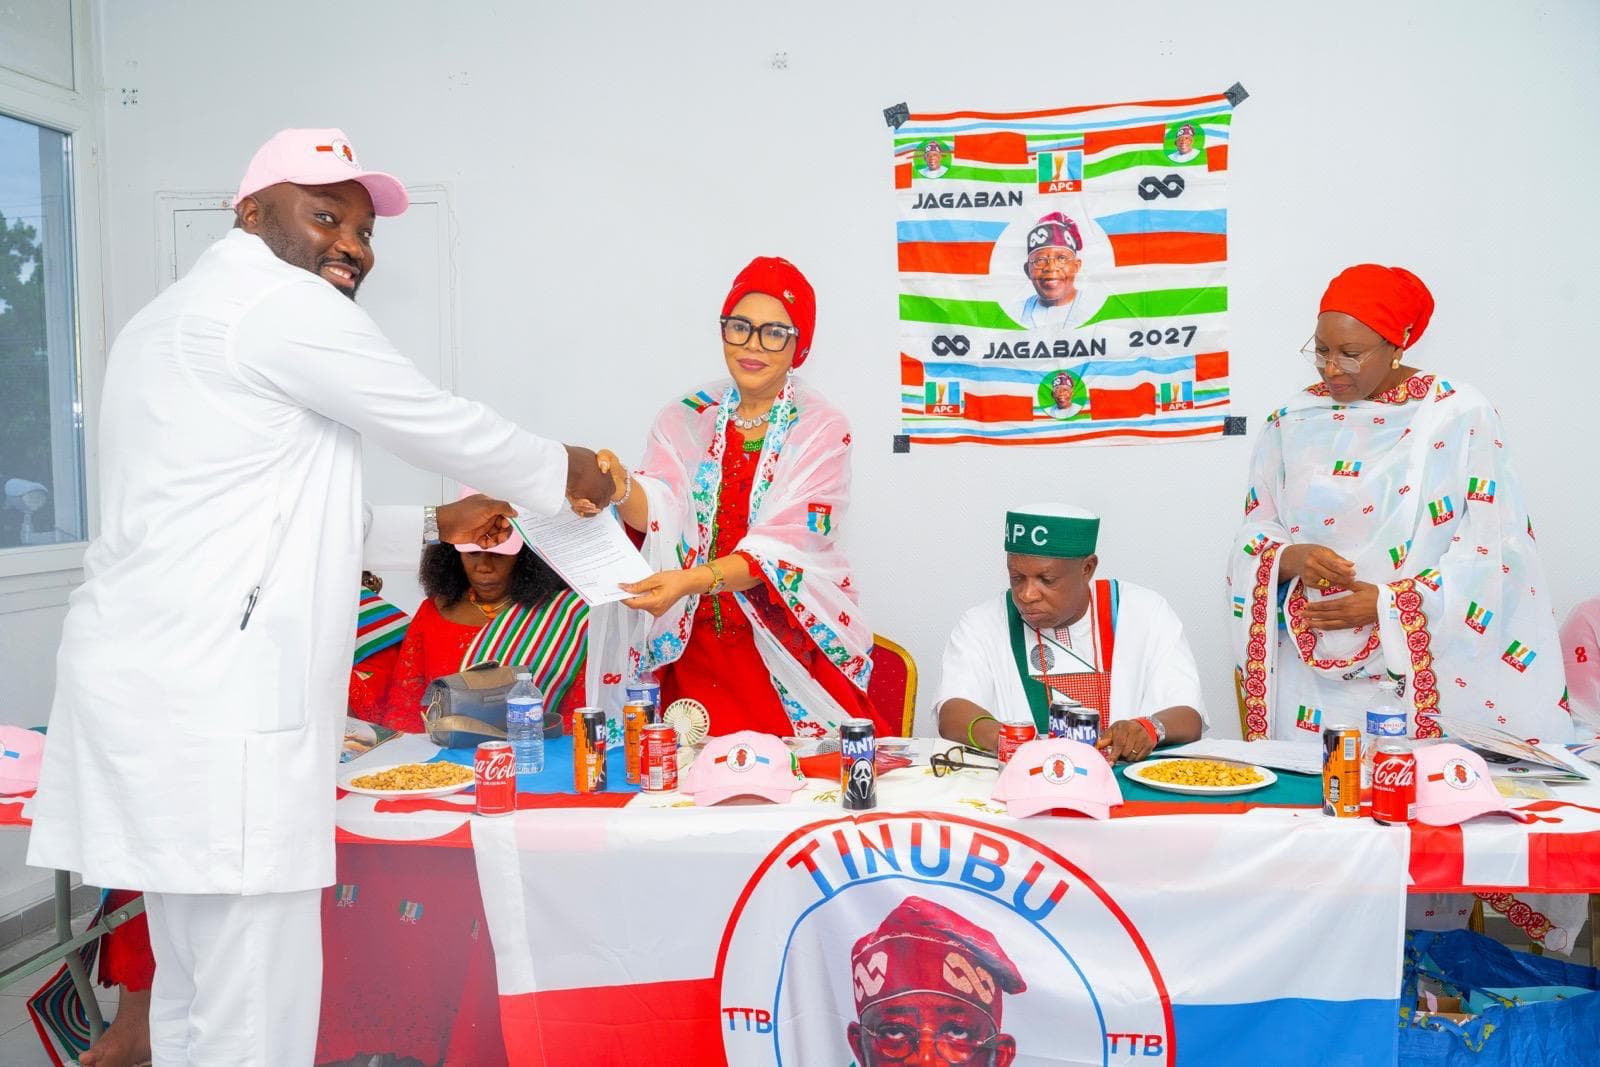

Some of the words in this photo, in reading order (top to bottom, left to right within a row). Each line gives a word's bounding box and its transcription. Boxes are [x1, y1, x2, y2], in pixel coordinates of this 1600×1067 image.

[1048, 182, 1074, 193] APC
[911, 190, 1023, 210] JAGABAN
[982, 338, 1107, 360] JAGABAN
[1128, 325, 1198, 348] 2027
[933, 405, 954, 414] APC
[1168, 402, 1188, 411] APC
[1470, 492, 1490, 501] APC
[1435, 512, 1451, 525] APC
[1418, 576, 1435, 588] APC
[1324, 585, 1341, 595] APC
[1466, 618, 1483, 632] APC
[1504, 655, 1523, 670] APC
[1299, 721, 1316, 731] APC
[786, 821, 1070, 922] TINUBU
[722, 1007, 773, 1034] TTB
[1106, 1033, 1164, 1057] TTB
